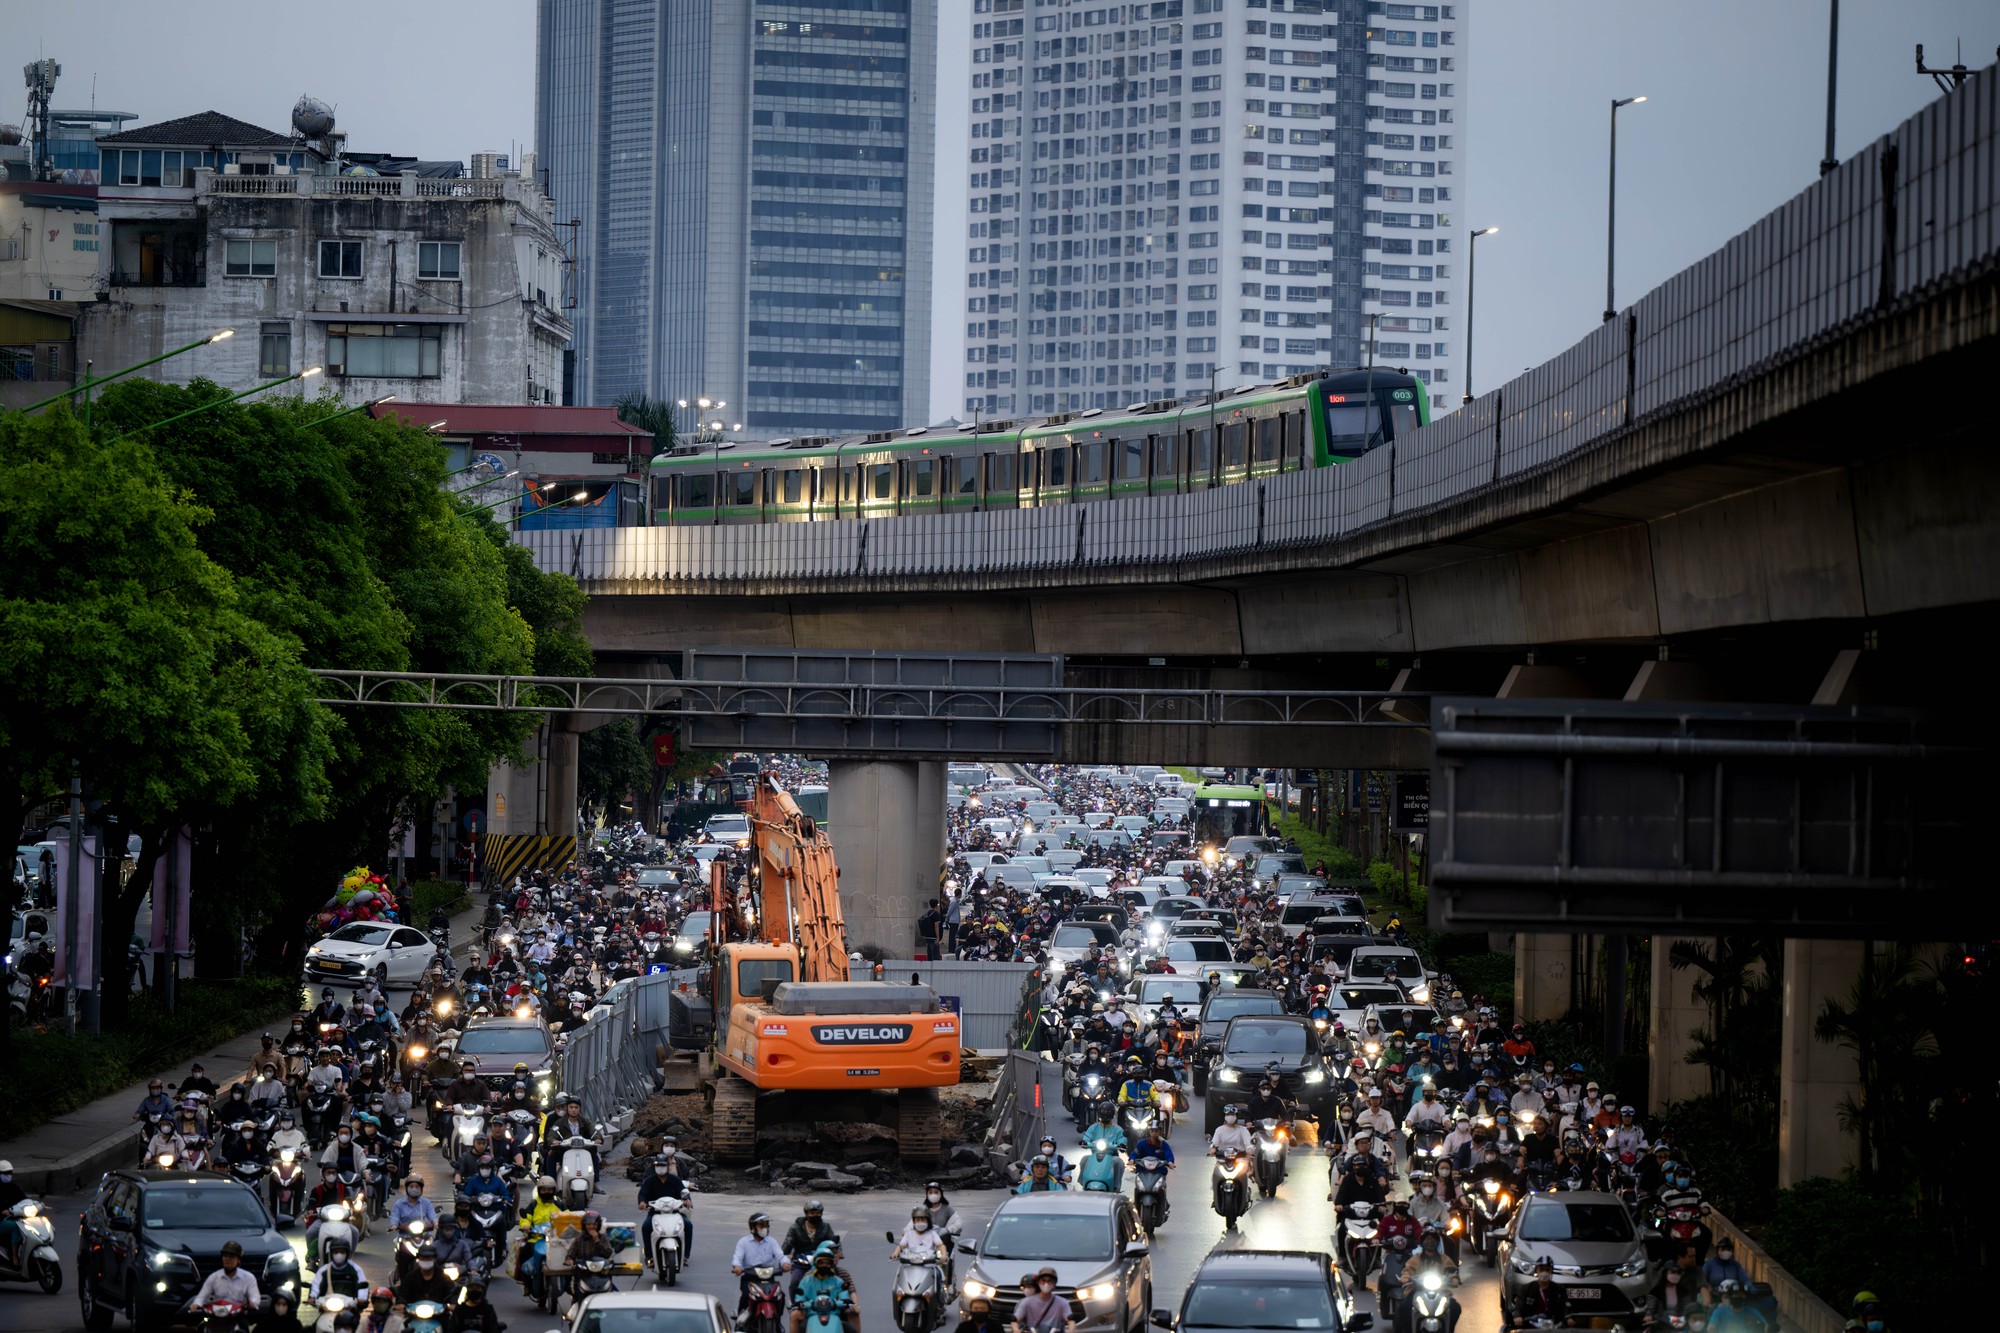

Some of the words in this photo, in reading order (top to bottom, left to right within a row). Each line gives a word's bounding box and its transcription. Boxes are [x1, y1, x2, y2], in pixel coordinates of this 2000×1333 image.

[73, 222, 93, 235] VAN
[1394, 391, 1411, 399] 003
[820, 1028, 904, 1041] DEVELON
